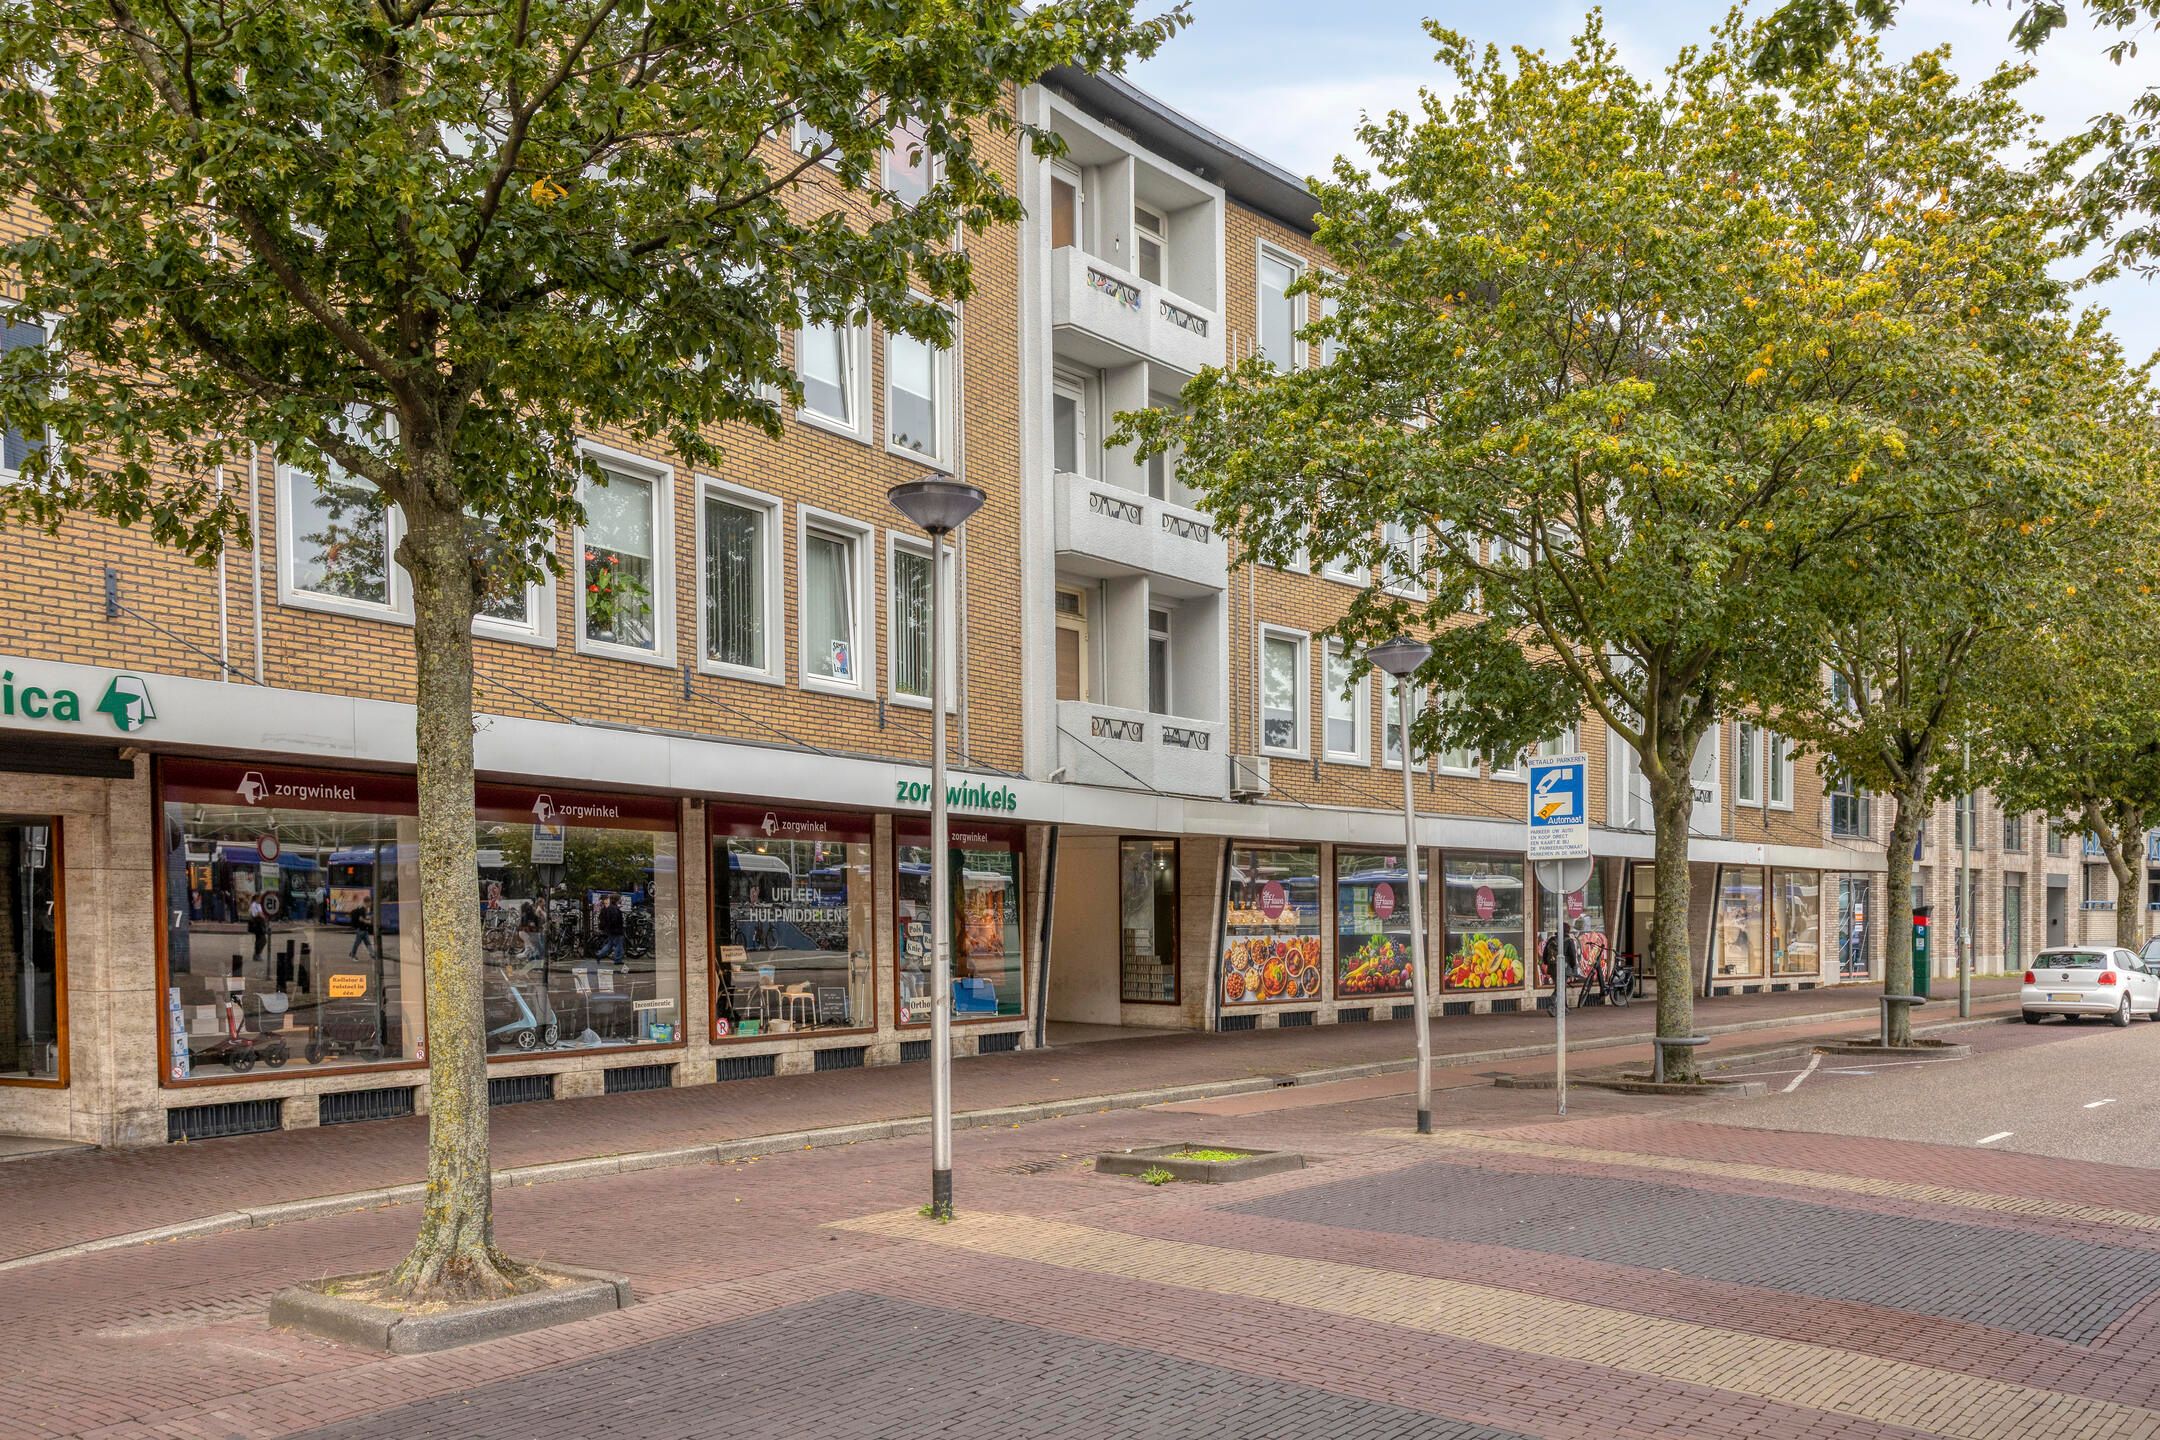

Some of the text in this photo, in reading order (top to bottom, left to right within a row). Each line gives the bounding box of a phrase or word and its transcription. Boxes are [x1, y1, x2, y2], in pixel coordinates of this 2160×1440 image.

[3, 670, 80, 721] ica
[275, 784, 356, 800] zorgwinkel
[897, 779, 1017, 811] zorwinkels
[560, 804, 620, 818] zorgwinkel
[782, 820, 827, 833] zorgwinkel
[1548, 815, 1582, 825] Automaat
[952, 832, 988, 843] zorgwinkel
[771, 887, 821, 901] UITLEEN
[46, 900, 54, 915] 7
[173, 910, 183, 927] 7
[750, 908, 842, 922] HULPMIDDELEN
[1918, 926, 1924, 934] P
[910, 1000, 931, 1010] Ortho
